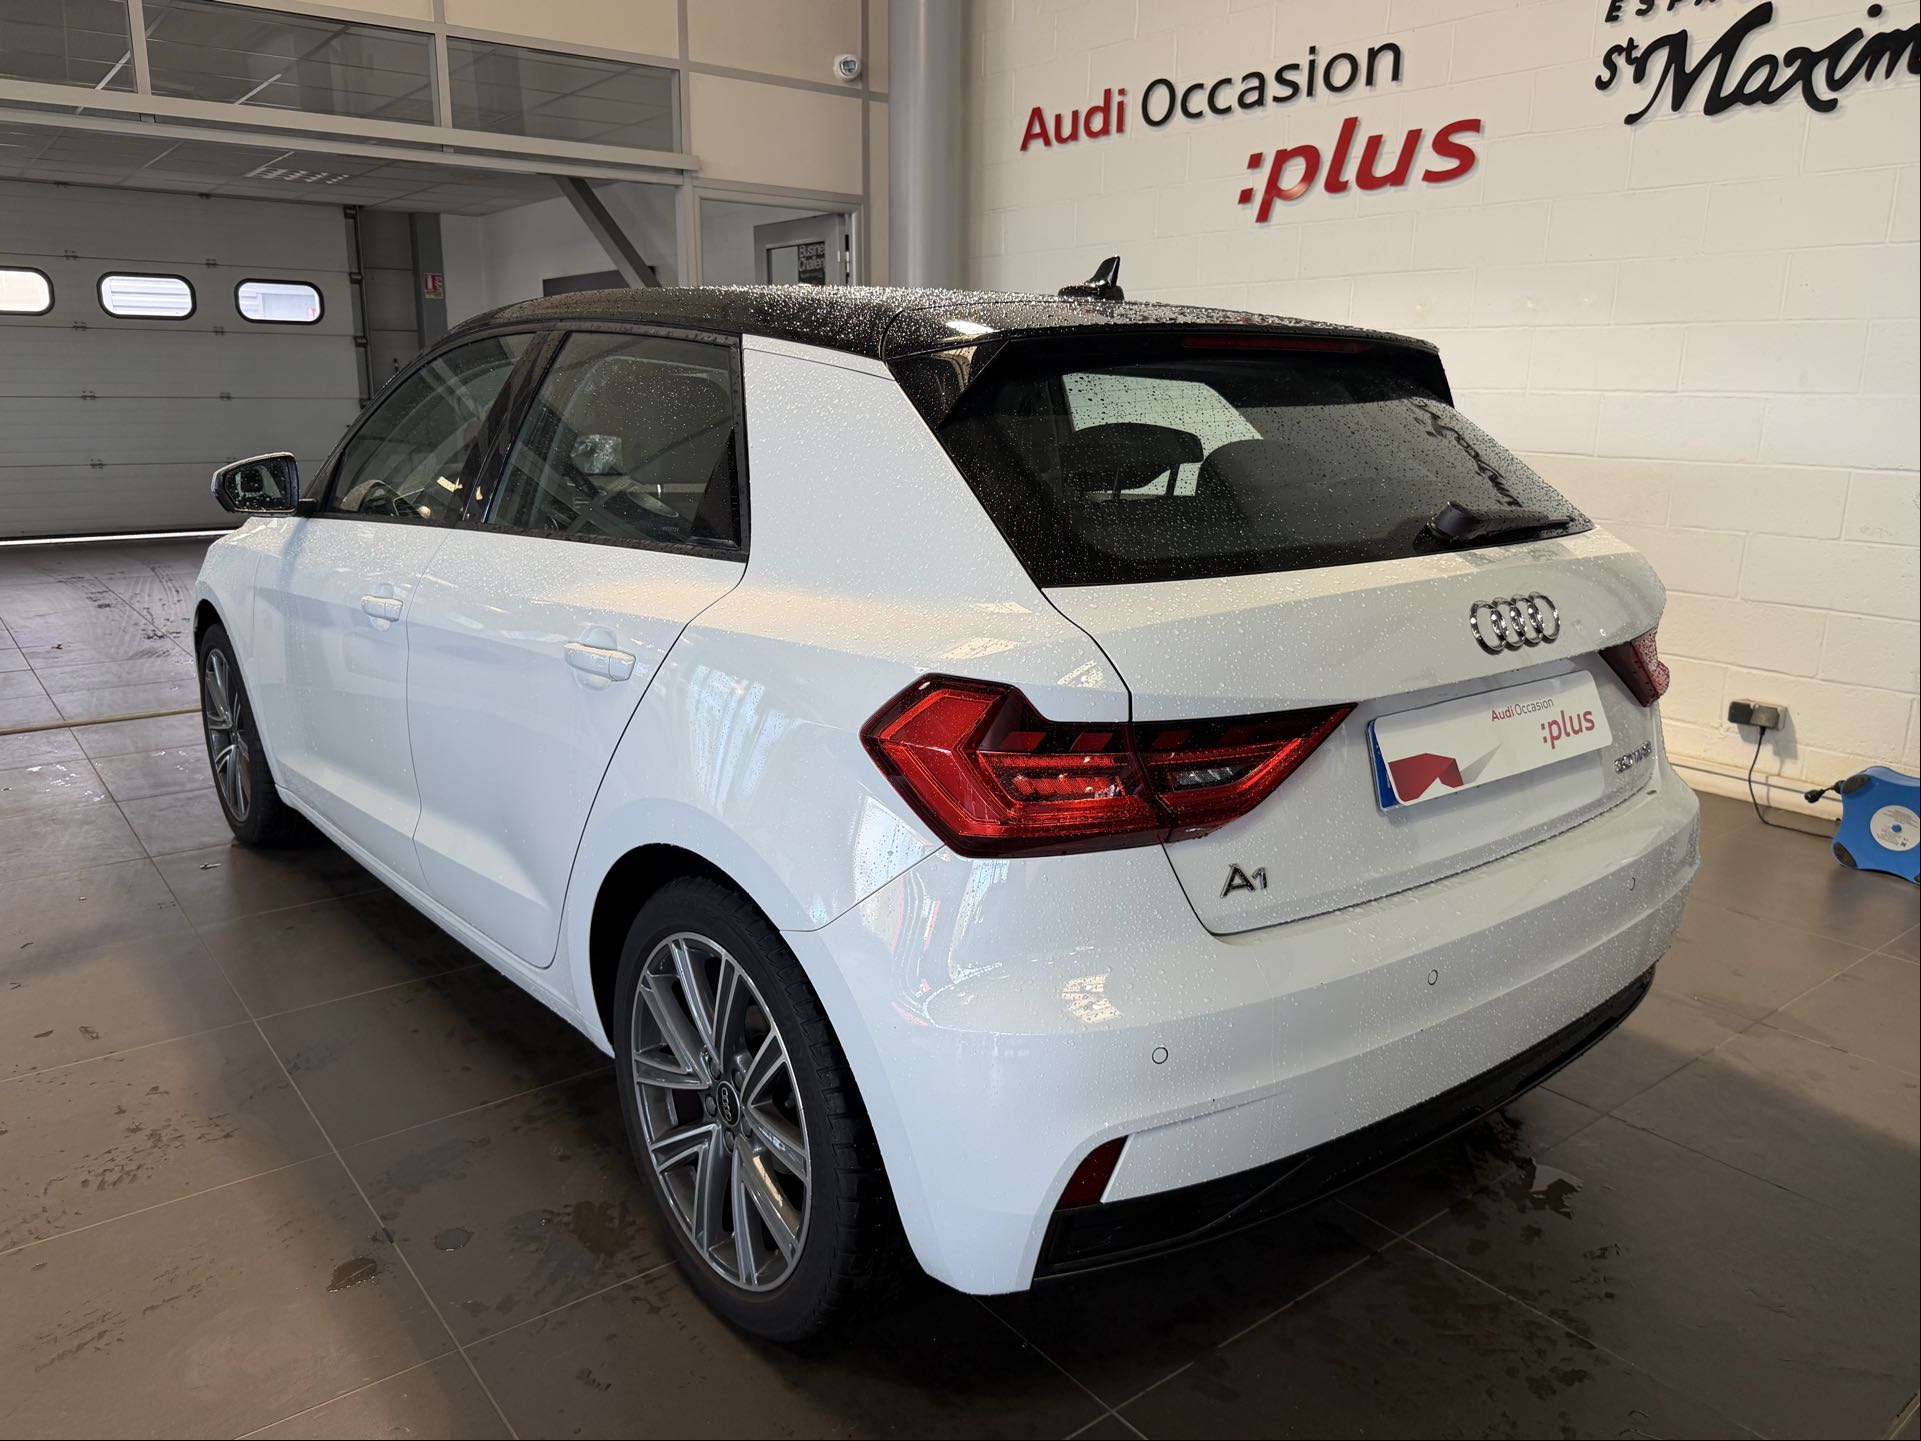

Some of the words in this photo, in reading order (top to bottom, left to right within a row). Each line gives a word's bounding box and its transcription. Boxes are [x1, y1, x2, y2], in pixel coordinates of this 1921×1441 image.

[1020, 88, 1126, 152] Audi
[1141, 42, 1402, 128] Occasion
[1237, 116, 1482, 224] :plus
[1491, 706, 1514, 722] Audi
[1514, 698, 1554, 716] Occasion
[1541, 710, 1595, 750] :plus
[1220, 863, 1267, 898] A1
